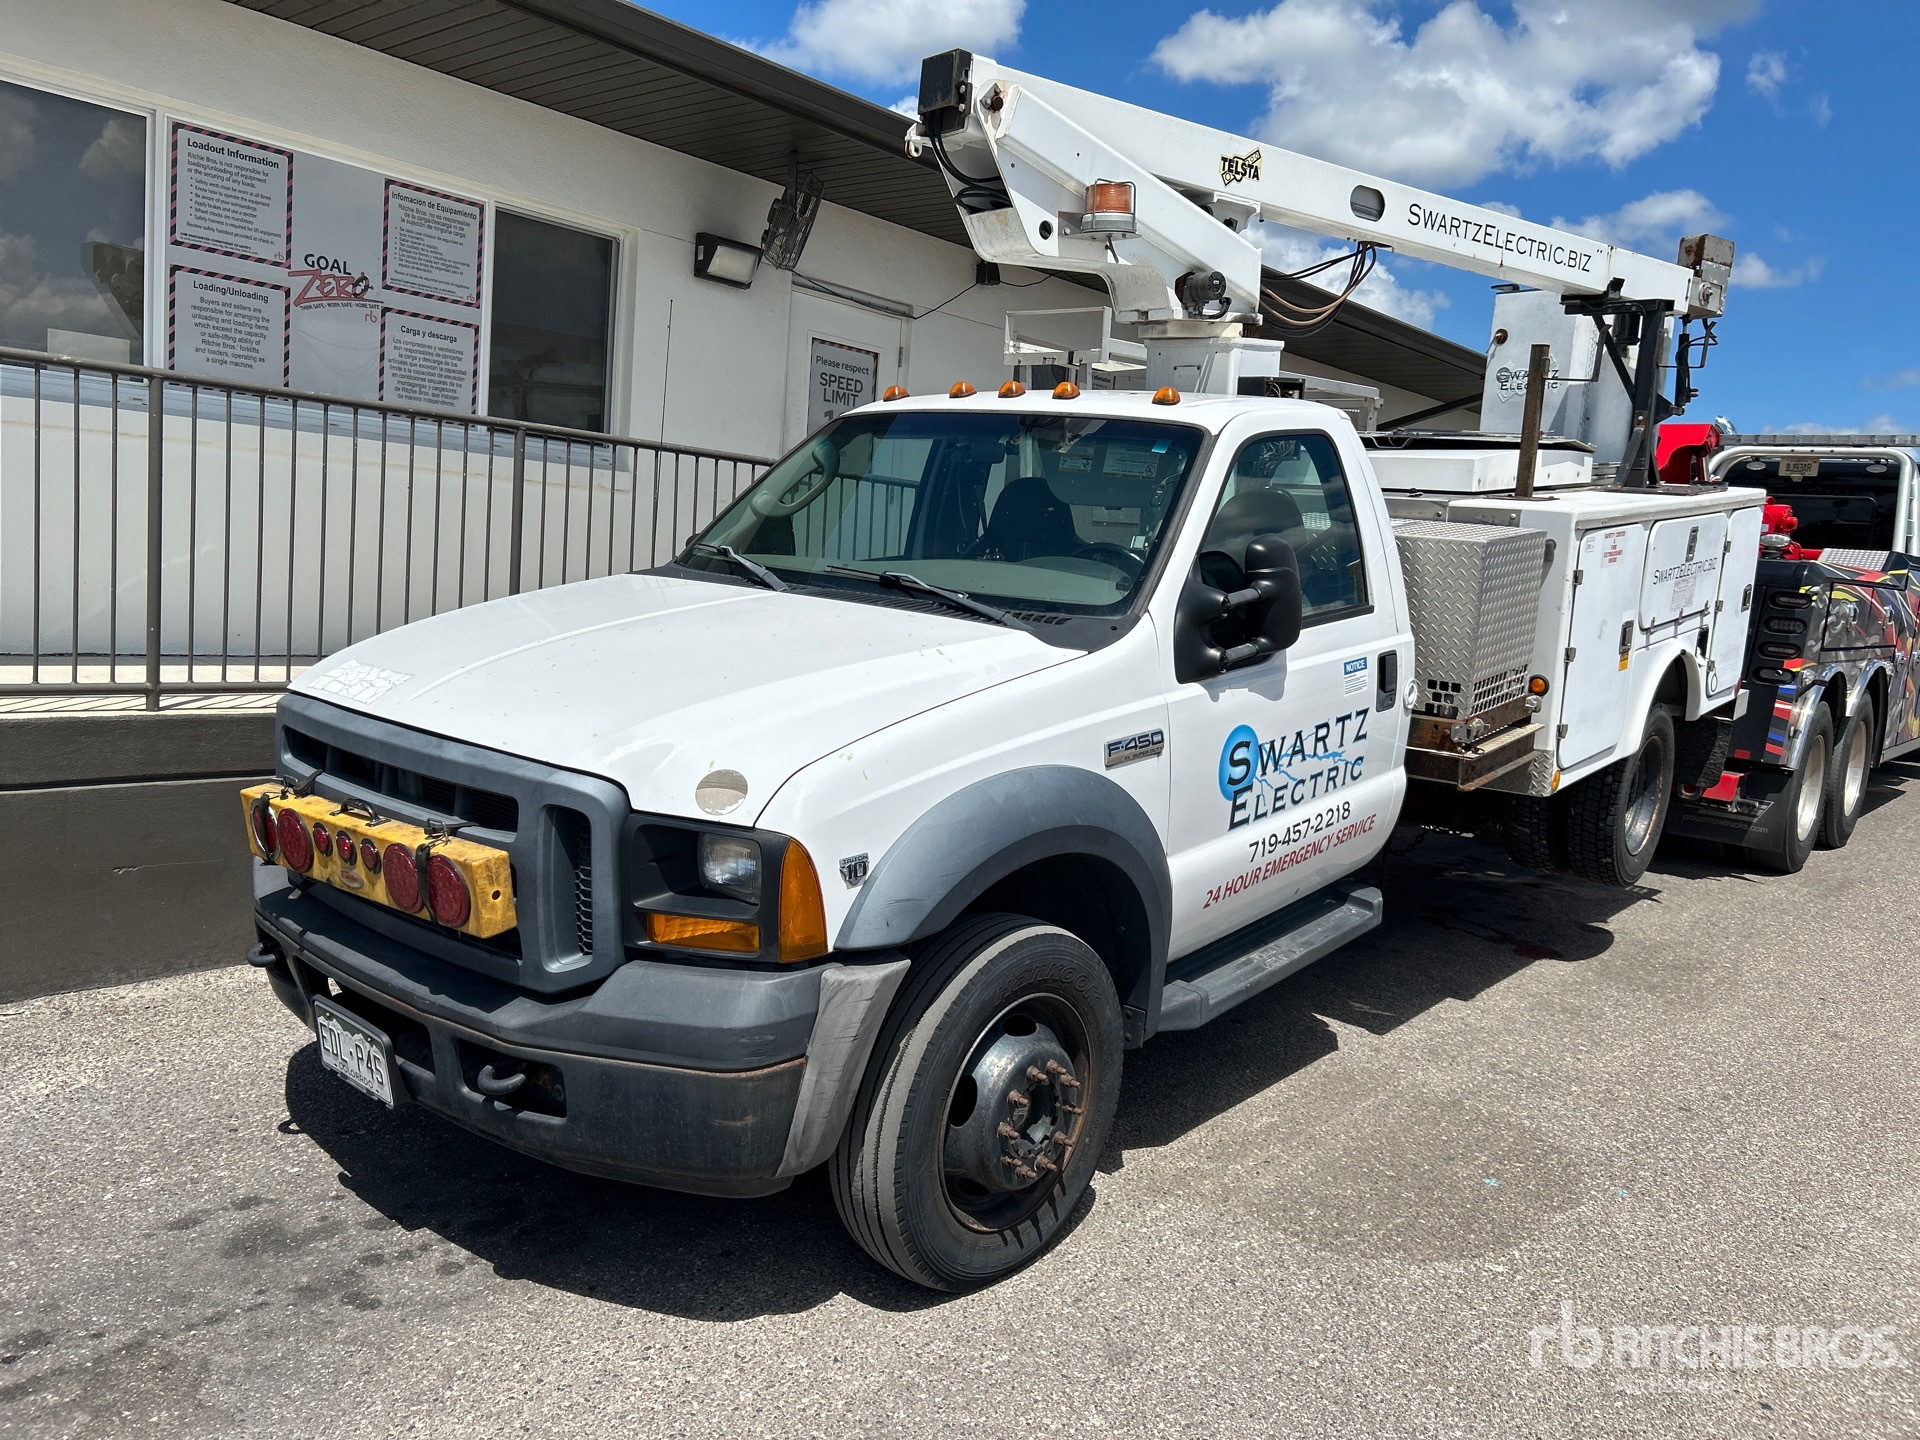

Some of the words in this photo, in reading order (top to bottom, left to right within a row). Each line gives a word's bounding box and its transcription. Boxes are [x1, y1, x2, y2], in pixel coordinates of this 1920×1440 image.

[188, 137, 225, 155] Loadout
[227, 148, 279, 169] Information
[1221, 156, 1260, 181] TELSTA
[428, 200, 435, 209] de
[304, 253, 352, 276] GOAL
[194, 280, 269, 304] Loading/Unloading
[200, 297, 220, 306] Buyers
[233, 304, 251, 312] sellers
[364, 310, 378, 323] rb
[401, 325, 420, 337] Carga
[422, 330, 426, 339] y
[428, 330, 457, 344] descarga
[816, 356, 840, 368] Please
[842, 362, 869, 375] respect
[820, 372, 863, 394] SPEED
[823, 388, 859, 407] LIMIT
[1346, 660, 1365, 672] NOTICE
[1108, 730, 1164, 758] F-450
[1226, 707, 1370, 787] SWARTZ
[1227, 756, 1364, 832] ELECTRIC
[1249, 802, 1351, 863] 719-457-2218
[1202, 888, 1221, 910] 24
[1222, 869, 1261, 900] HOUR
[1262, 834, 1334, 882] EMERGENCY
[1334, 813, 1377, 847] SERVICE
[339, 1062, 373, 1088] COLORADO
